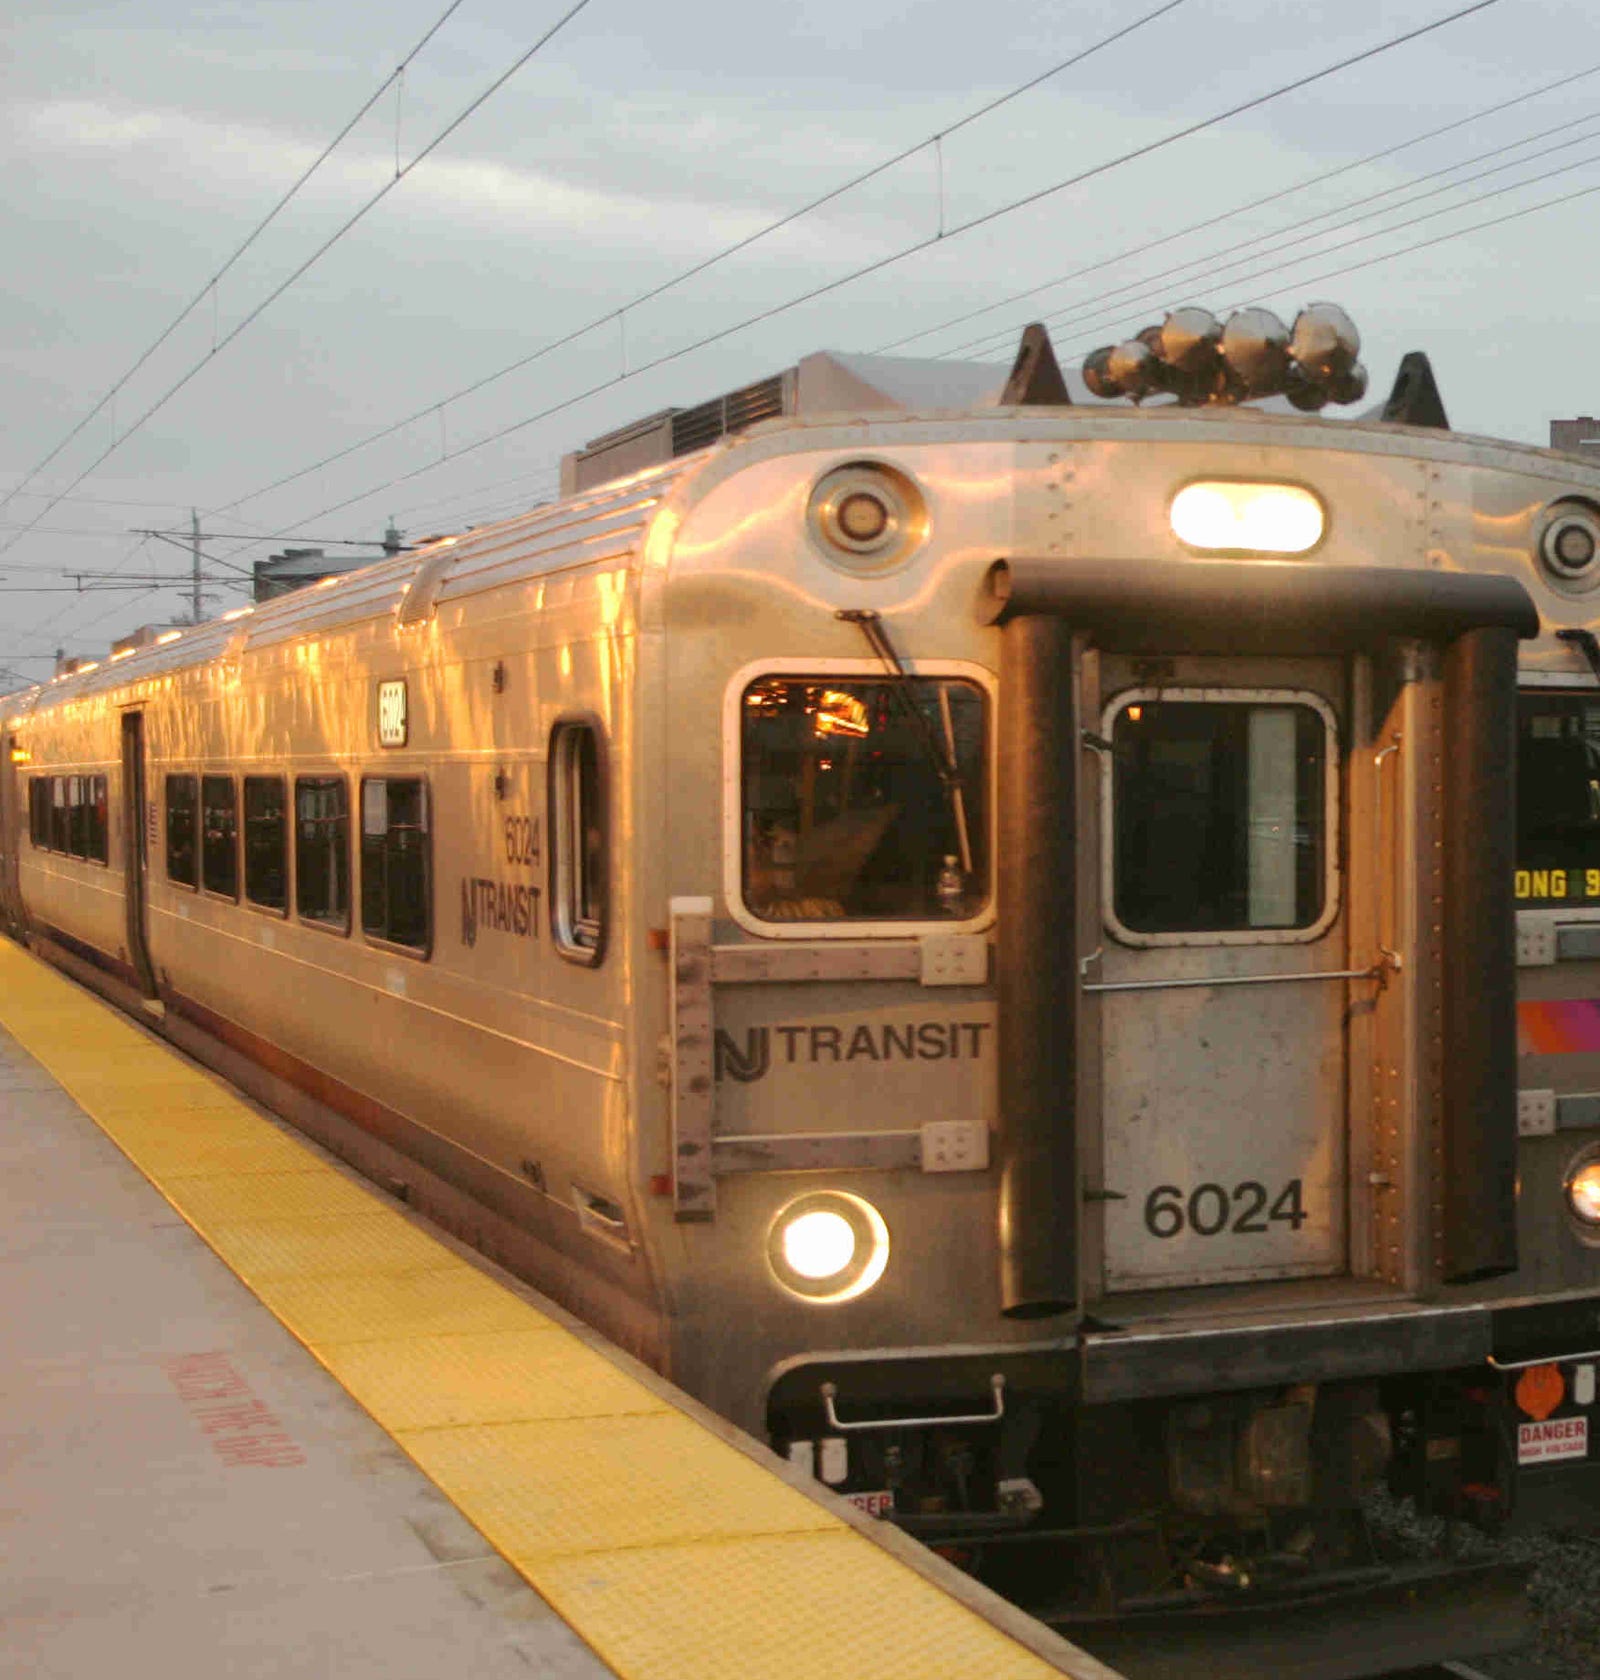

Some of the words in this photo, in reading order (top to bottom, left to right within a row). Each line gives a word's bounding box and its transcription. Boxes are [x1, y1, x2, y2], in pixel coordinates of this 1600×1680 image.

[504, 816, 540, 866] 6024
[1515, 870, 1566, 898] ONG
[776, 1022, 991, 1063] TRANSIT
[1144, 1179, 1308, 1239] 6024
[1520, 1420, 1585, 1444] DANGER
